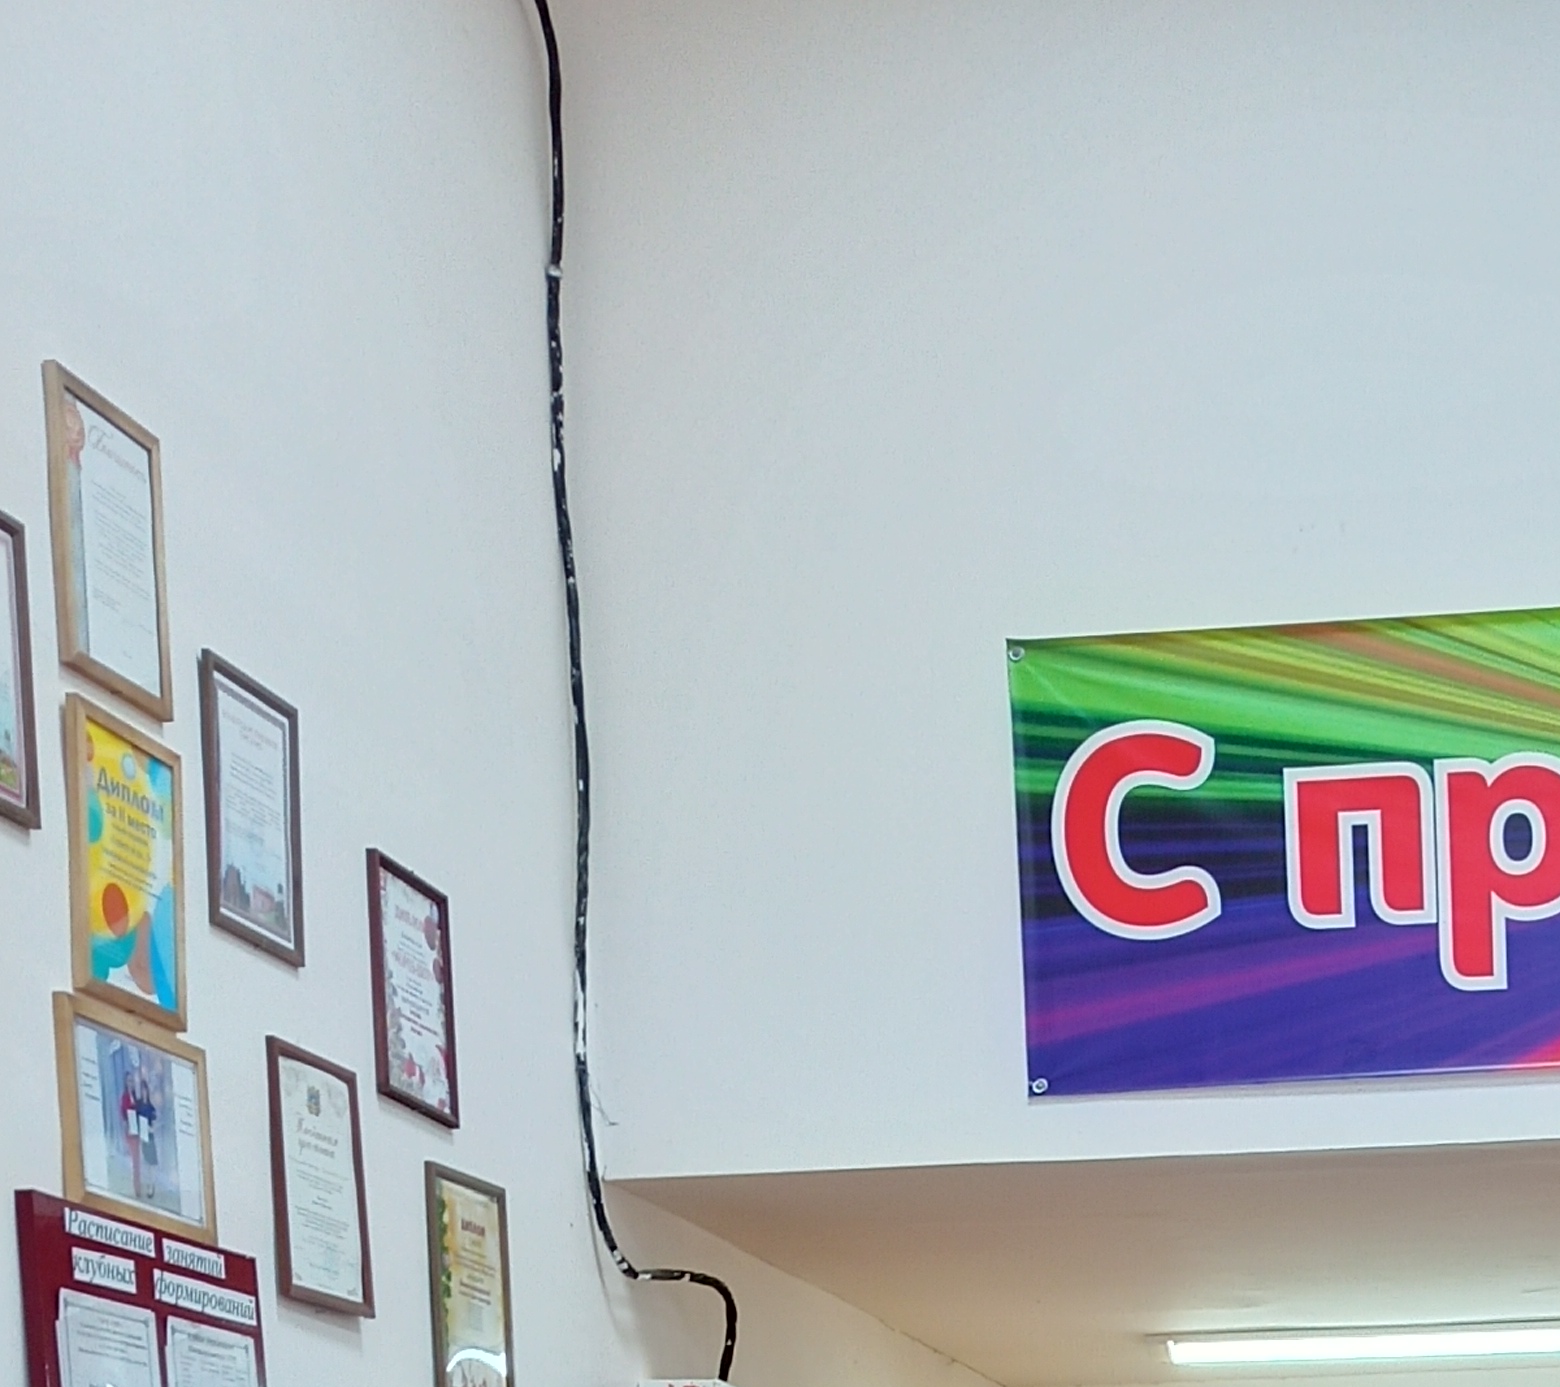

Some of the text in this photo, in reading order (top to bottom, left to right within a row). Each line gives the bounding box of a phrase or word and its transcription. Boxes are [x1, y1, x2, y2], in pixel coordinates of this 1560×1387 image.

[1050, 721, 1221, 941] С
[68, 1209, 222, 1278] Расписание занятий
[74, 1255, 254, 1321] клубных формирований
